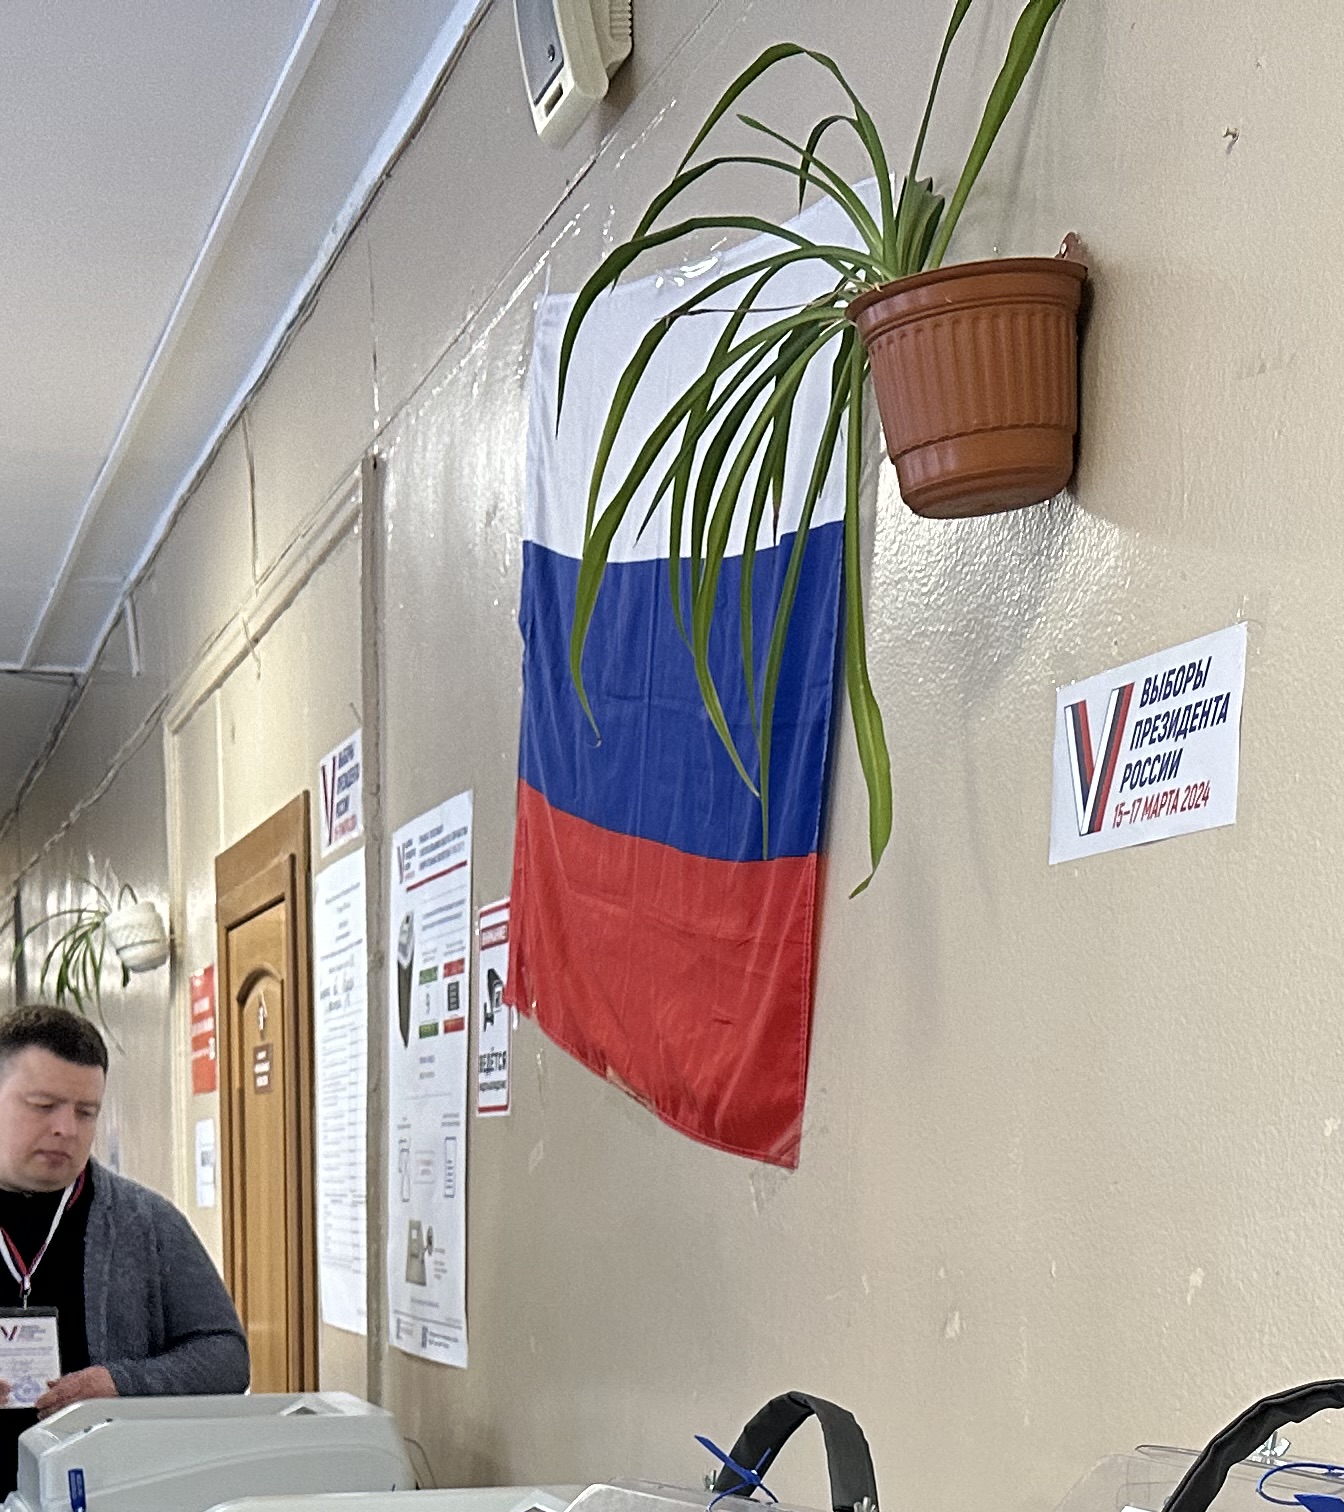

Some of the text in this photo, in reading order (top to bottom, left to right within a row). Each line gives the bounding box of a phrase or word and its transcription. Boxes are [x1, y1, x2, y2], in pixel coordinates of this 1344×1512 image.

[1139, 656, 1212, 708] ВЫБОРЫ
[1130, 692, 1231, 751] ПРЕЗИДЕНТА
[1119, 748, 1183, 793] РОССИИ
[1141, 788, 1179, 822] МАРТА
[1179, 780, 1211, 812] 2024
